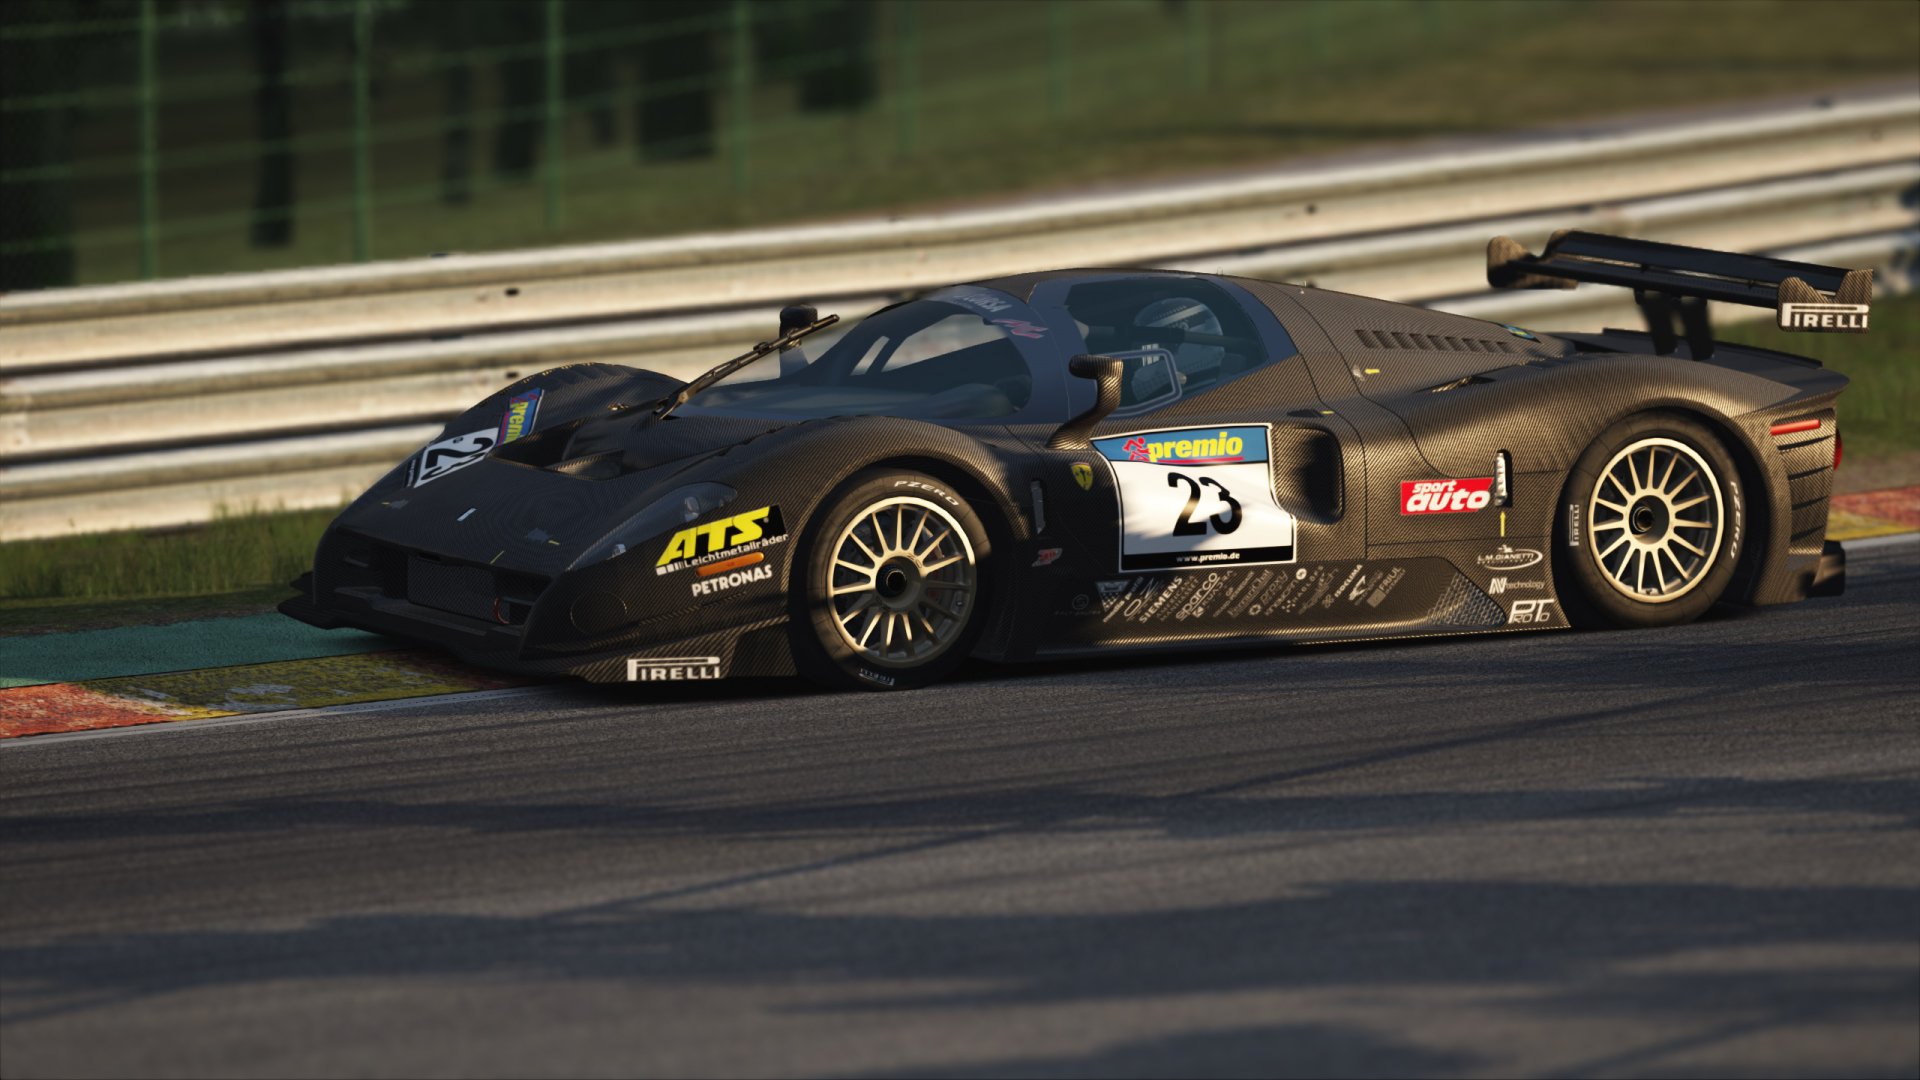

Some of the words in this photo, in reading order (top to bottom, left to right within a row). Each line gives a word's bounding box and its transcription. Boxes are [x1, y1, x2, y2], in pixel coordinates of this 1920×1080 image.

[1782, 302, 1869, 328] PIRELLI
[1147, 432, 1242, 462] premio
[1406, 489, 1490, 513] auto
[1413, 480, 1456, 494] sport
[1168, 472, 1242, 536] 23
[656, 506, 770, 566] ATS
[1569, 504, 1580, 546] PIRELLI
[1175, 551, 1241, 564] www.premio.de
[691, 565, 773, 597] PETRONAS
[1175, 572, 1218, 621] sparco
[1334, 564, 1363, 598] ISOCLIMA
[1139, 576, 1183, 623] SIEMENS
[627, 656, 721, 682] PIRELLI
